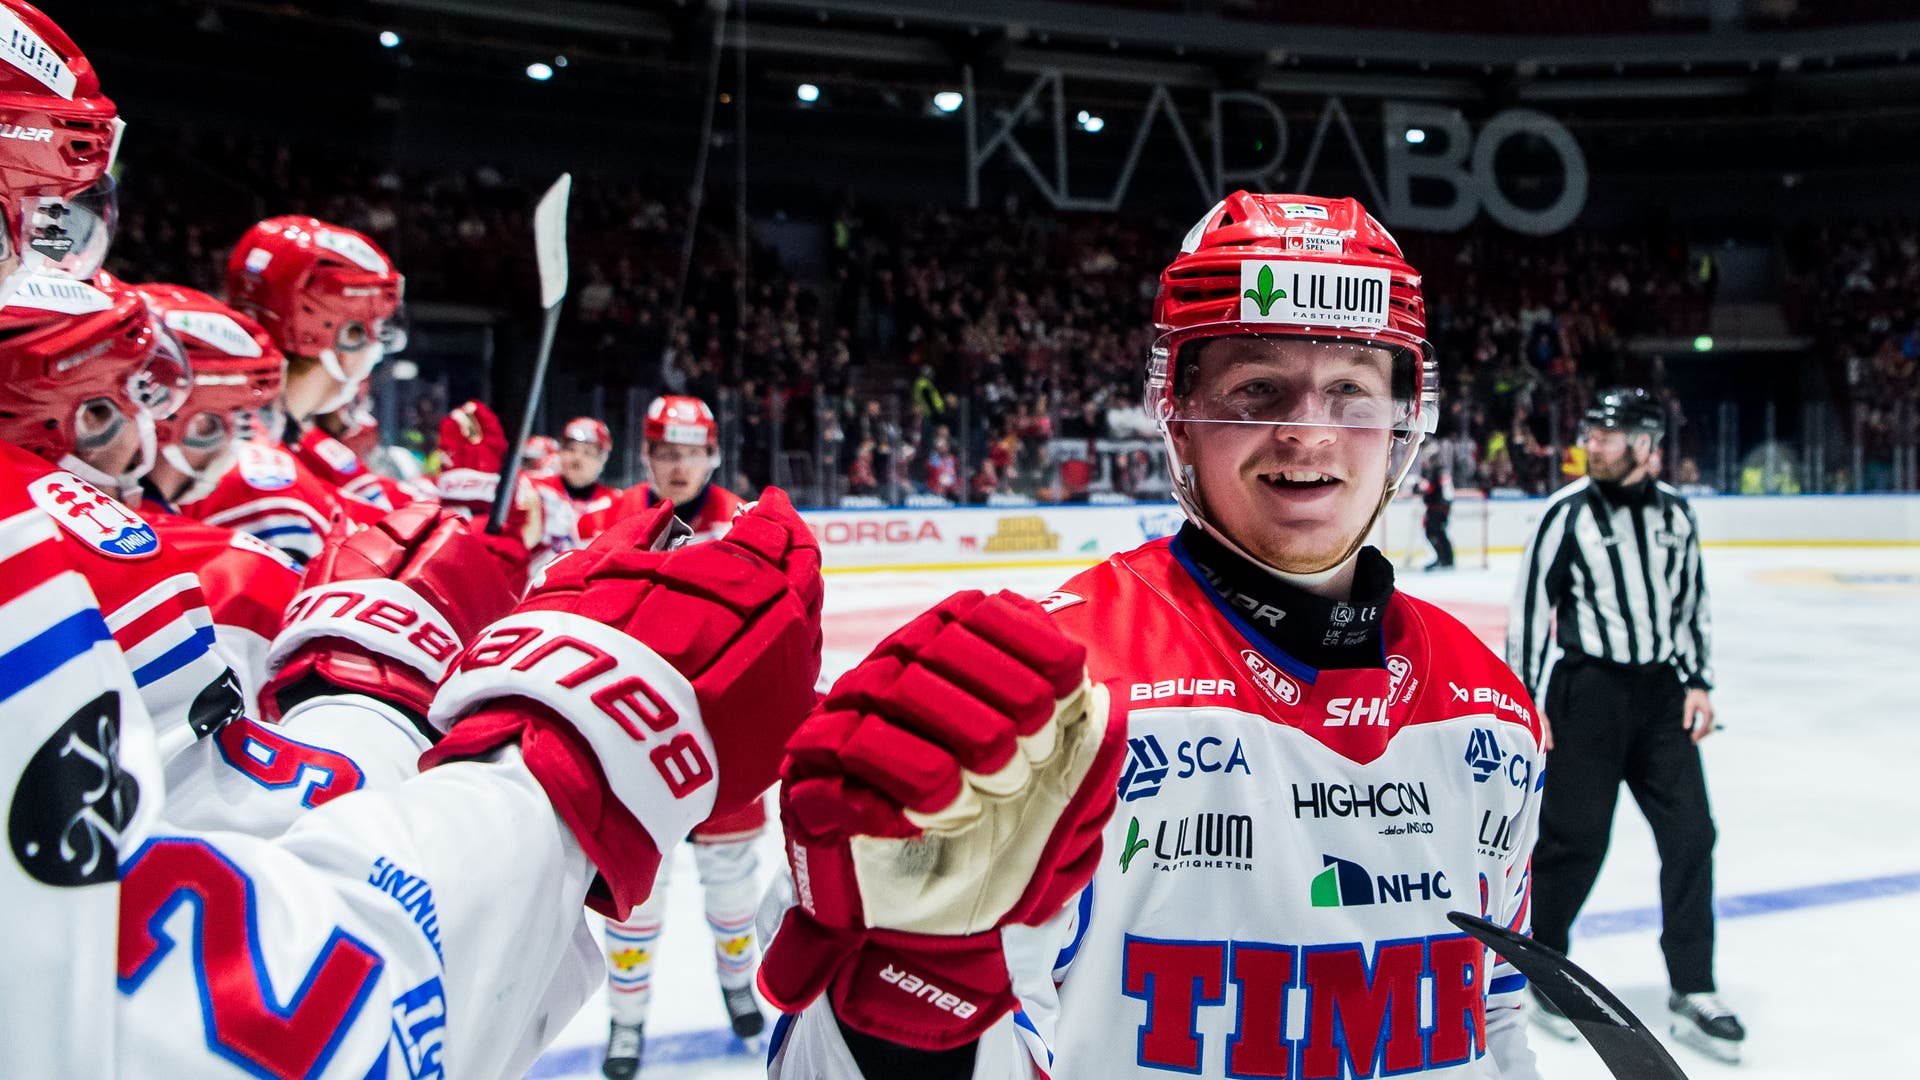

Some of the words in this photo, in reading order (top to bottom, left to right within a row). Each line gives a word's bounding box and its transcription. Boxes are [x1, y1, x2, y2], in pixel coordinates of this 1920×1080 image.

[963, 63, 1589, 237] KLARABO
[1306, 237, 1341, 246] SVENSKA
[1292, 273, 1384, 314] LILIUM
[1293, 312, 1382, 324] FASTIGHETER
[1246, 652, 1296, 702] EAB
[1387, 658, 1409, 703] AB
[444, 626, 714, 800] BAUE
[1322, 697, 1390, 727] SHL
[1177, 736, 1251, 779] SCA
[1291, 781, 1431, 819] HIGHCON
[1154, 812, 1253, 861] LILIUM
[1152, 859, 1253, 872] FASTIGHETER
[1376, 870, 1452, 904] NHC
